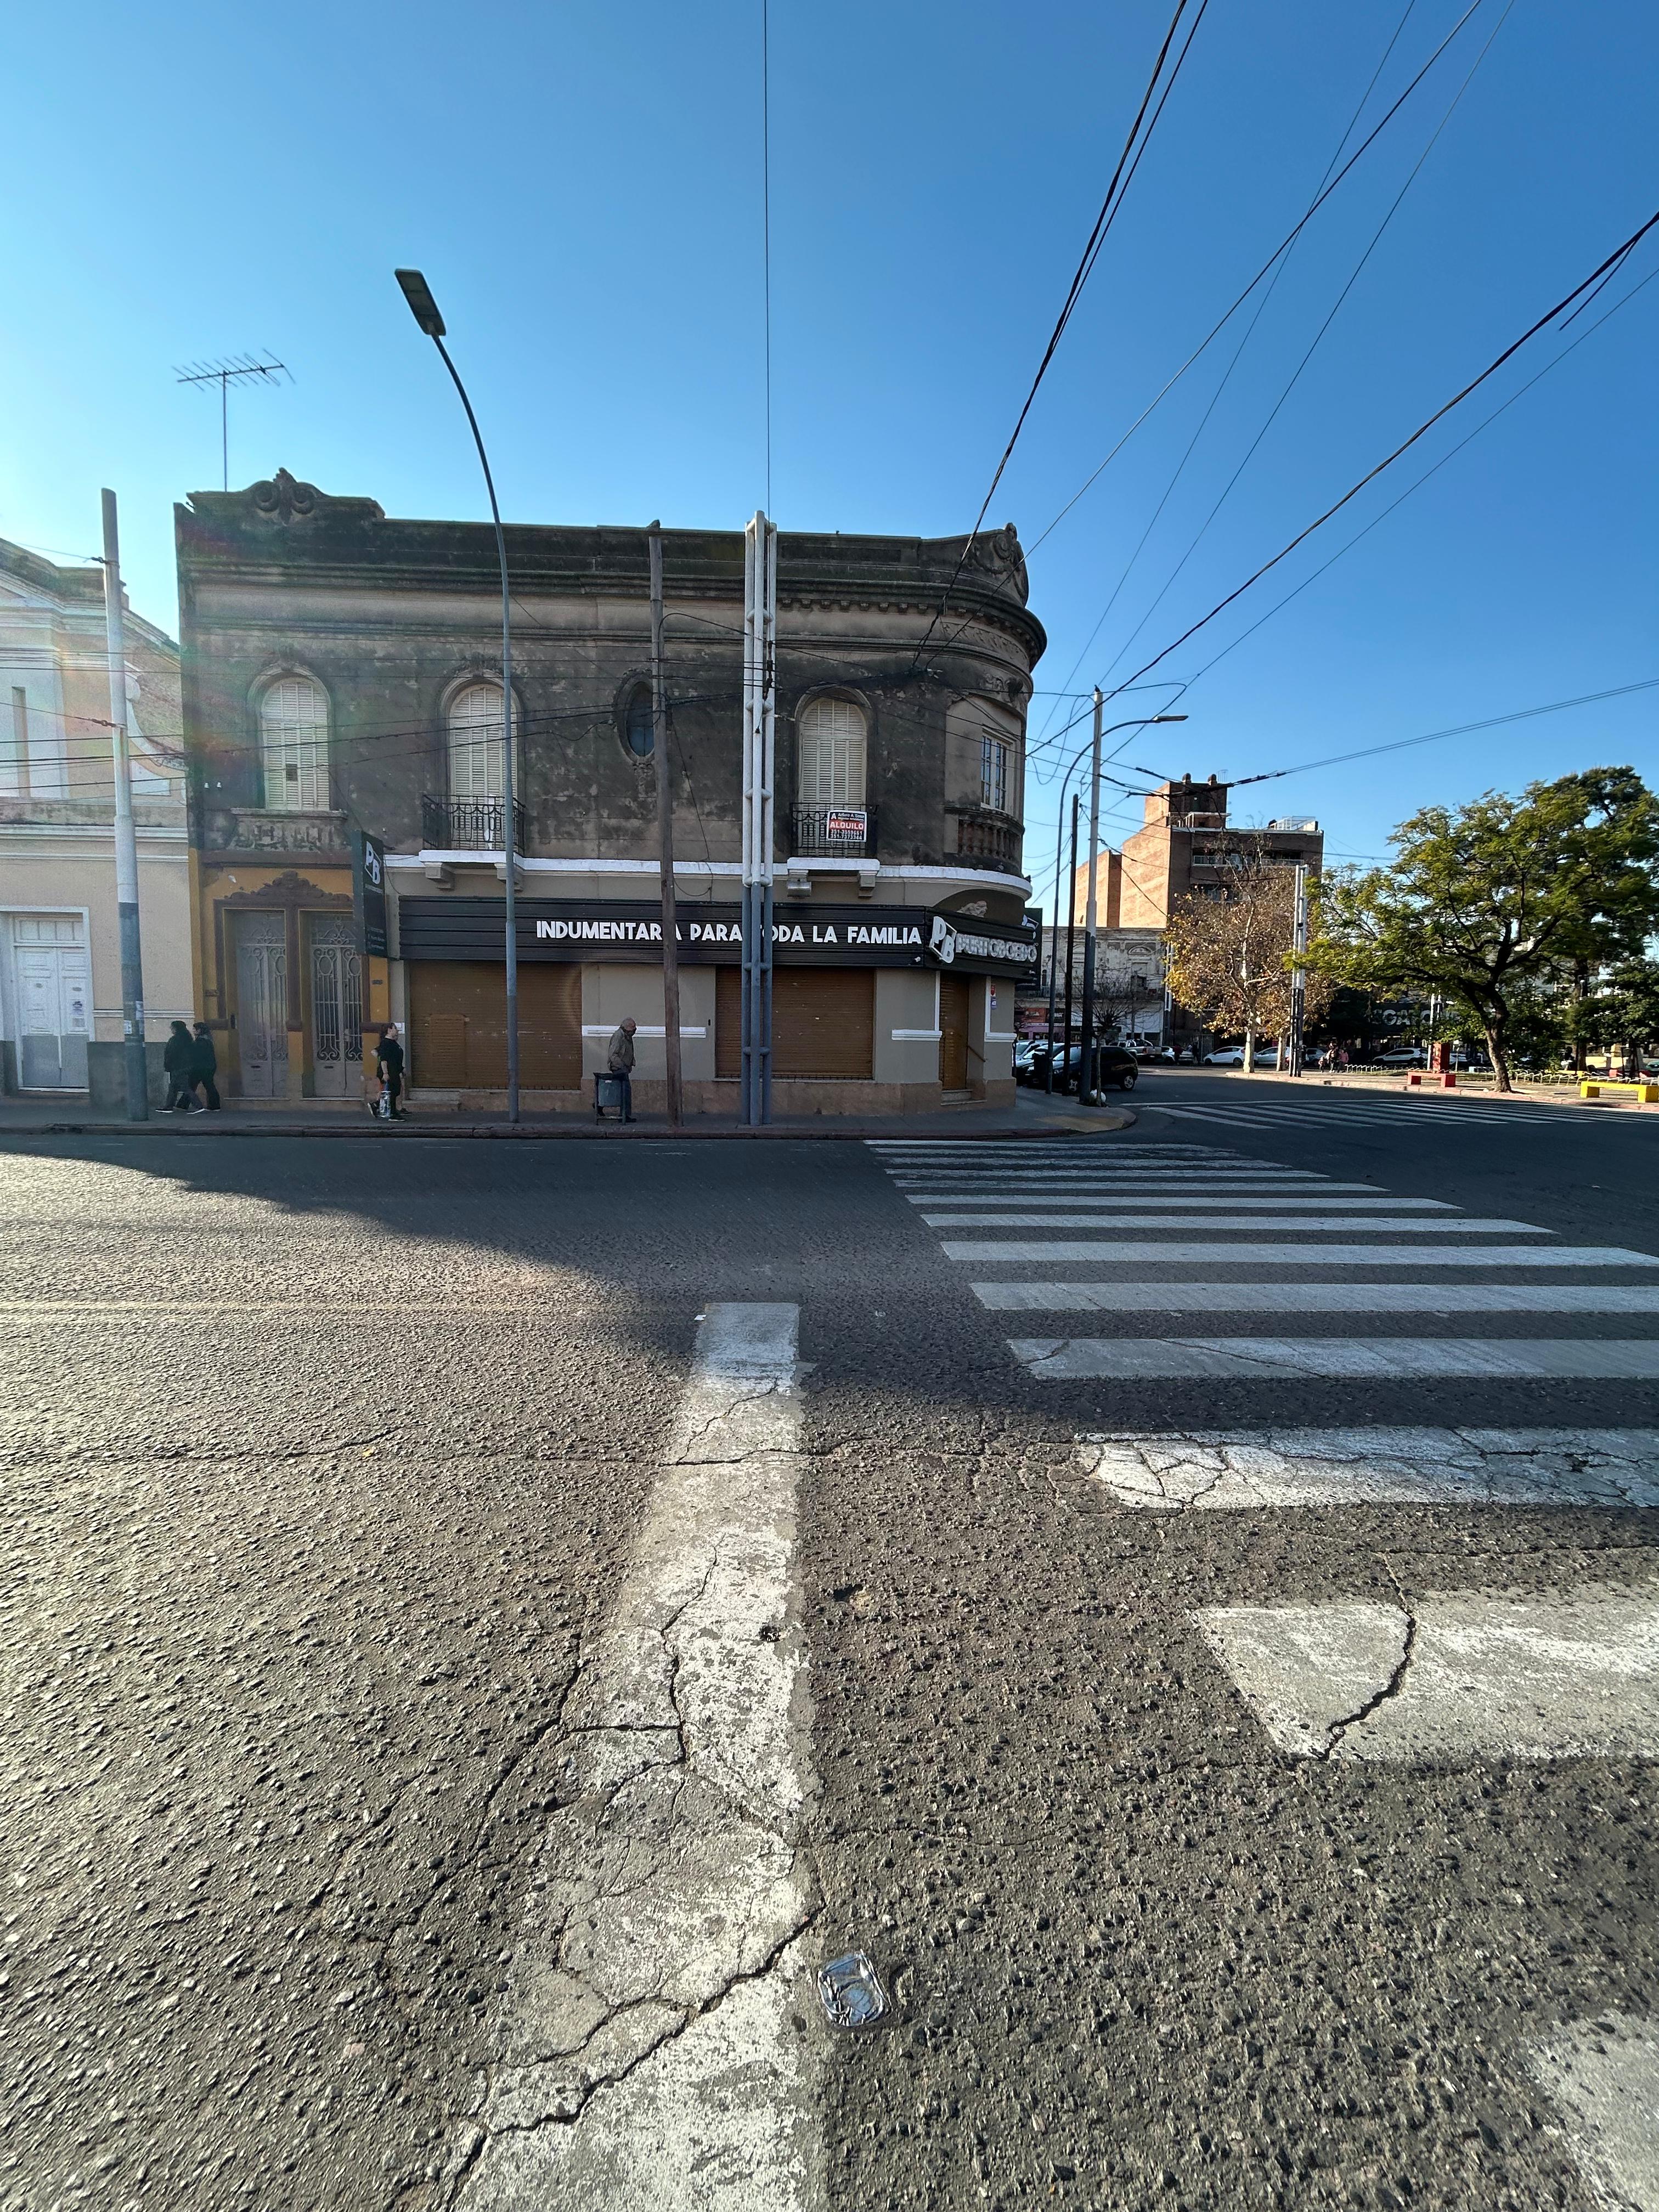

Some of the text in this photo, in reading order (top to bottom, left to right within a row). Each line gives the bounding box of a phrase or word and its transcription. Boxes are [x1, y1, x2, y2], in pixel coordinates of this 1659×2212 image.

[830, 822, 864, 830] ALQUILO
[537, 921, 922, 945] INDUMENTAR PARA ODA LA FAMILIA
